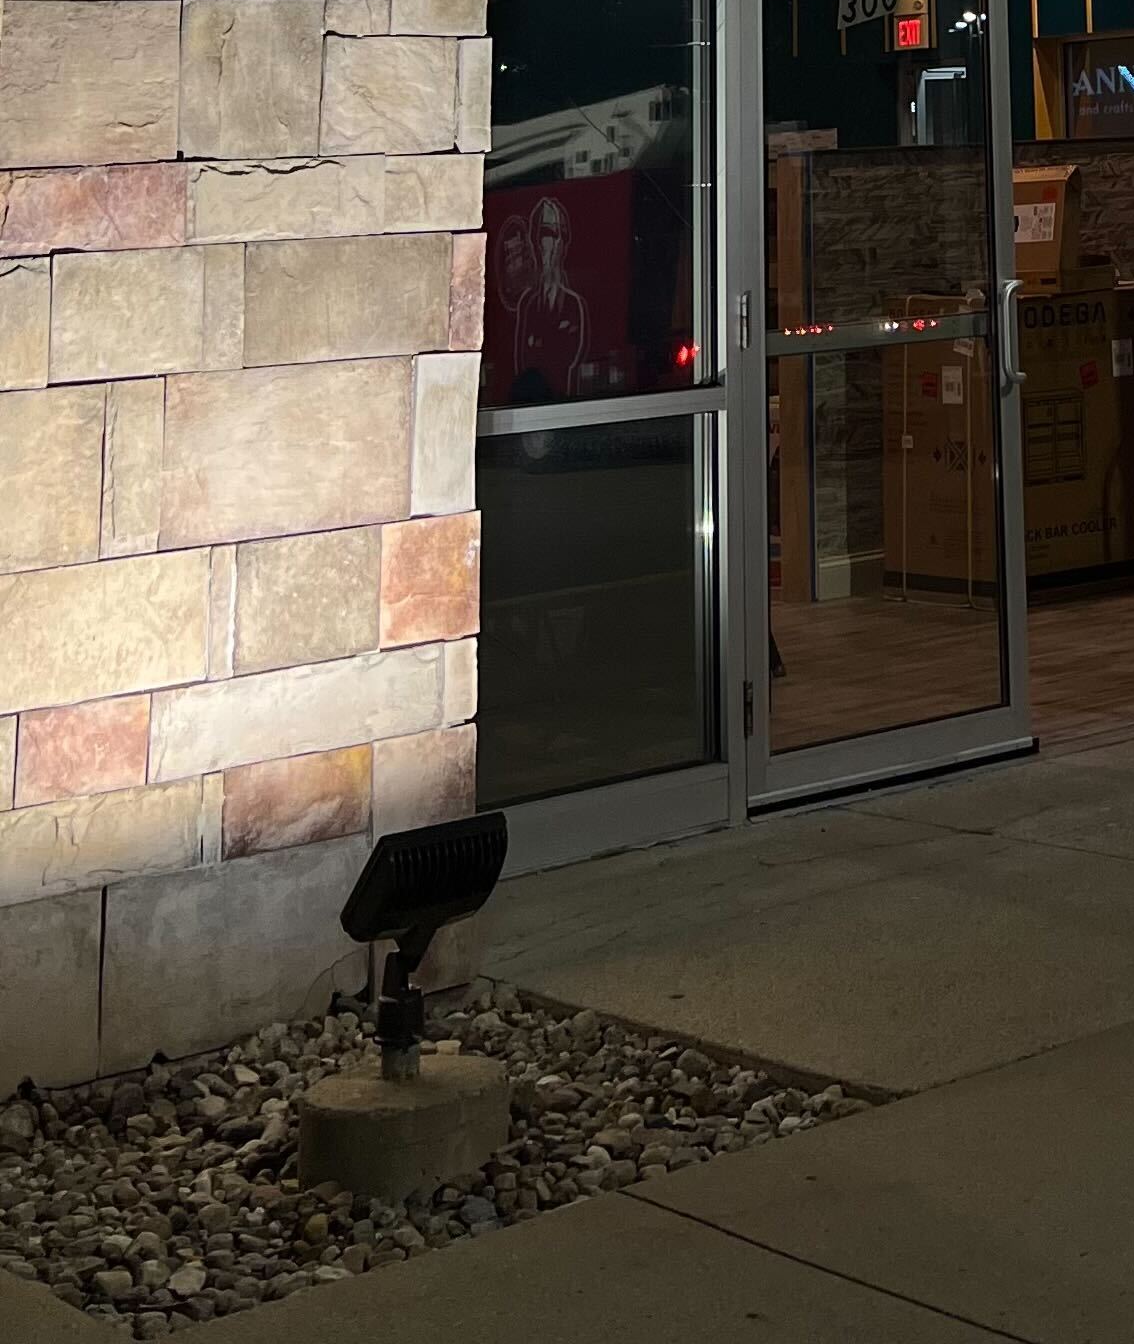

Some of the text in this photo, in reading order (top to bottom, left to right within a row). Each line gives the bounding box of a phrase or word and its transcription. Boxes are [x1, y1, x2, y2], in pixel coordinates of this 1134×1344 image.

[898, 19, 921, 46] EXIT
[1023, 301, 1107, 329] ODEGA
[1045, 524, 1068, 539] BAR
[1071, 518, 1117, 535] COOLER
